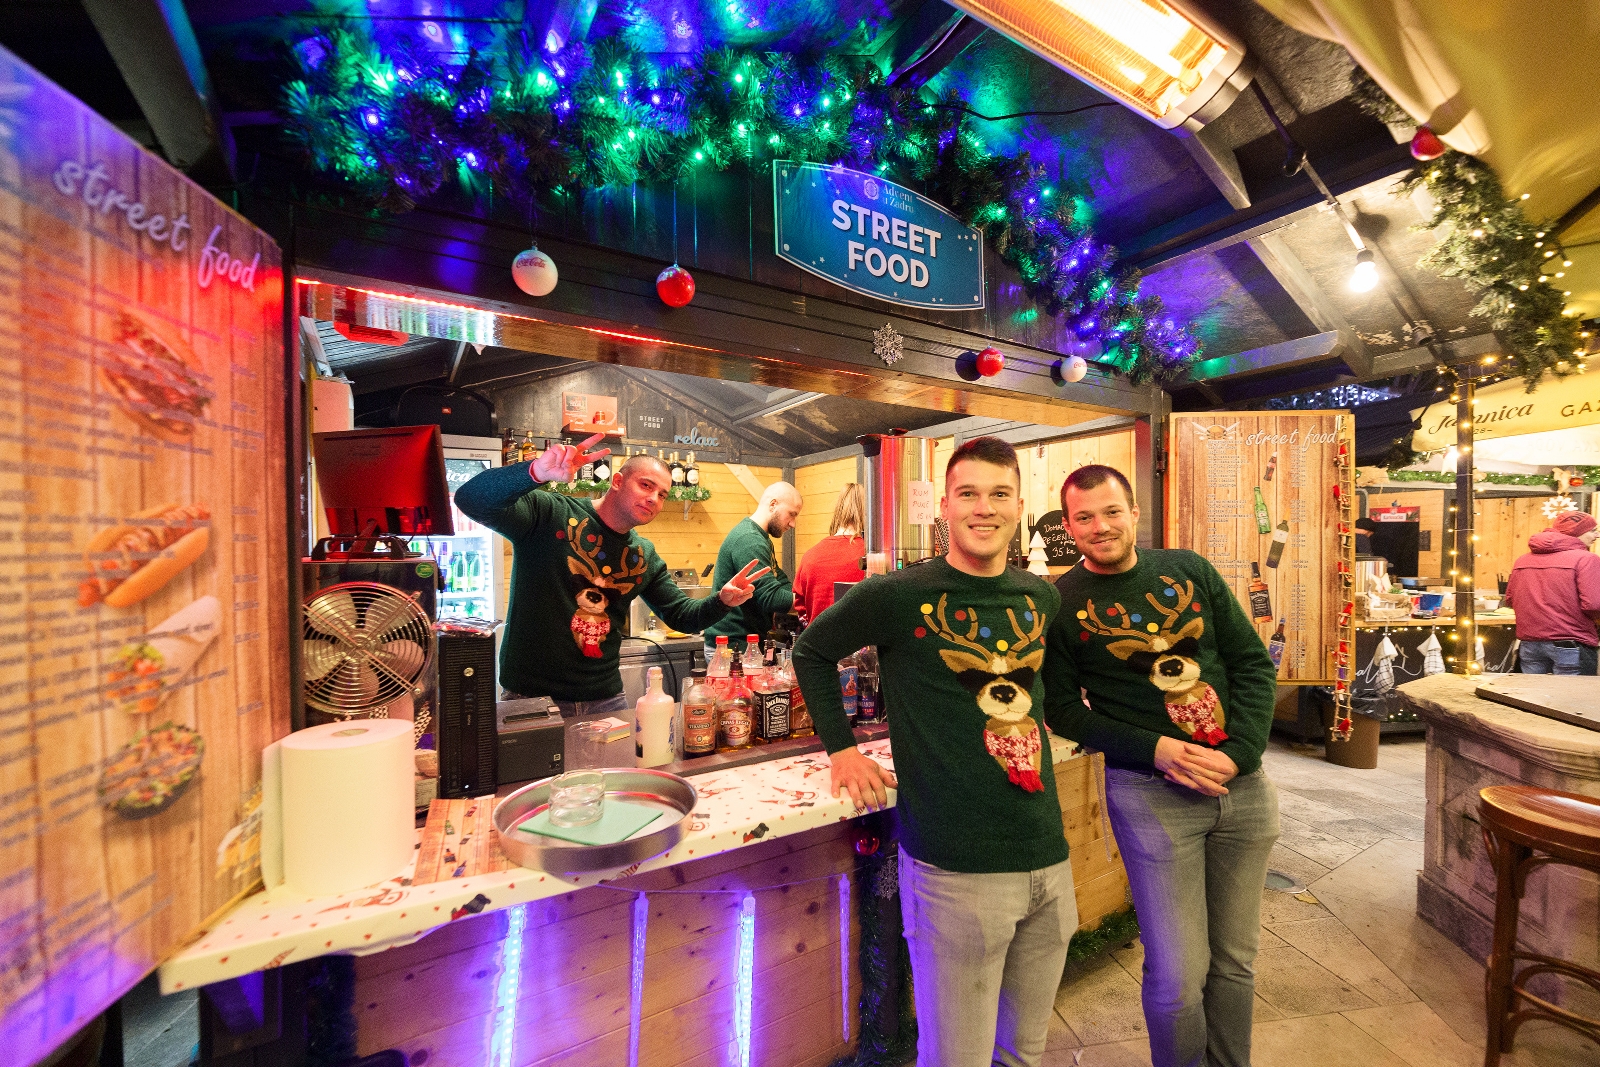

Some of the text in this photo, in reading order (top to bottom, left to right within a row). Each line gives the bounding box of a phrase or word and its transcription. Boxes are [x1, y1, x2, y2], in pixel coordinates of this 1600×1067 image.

[884, 184, 913, 203] Advent
[889, 196, 914, 213] Zadru
[53, 159, 191, 251] street
[199, 225, 261, 291] food
[831, 199, 941, 258] STREET
[848, 240, 929, 288] FOOD
[639, 415, 664, 423] STREET
[643, 421, 661, 429] FOOD
[673, 426, 719, 447] relax
[1245, 424, 1338, 452] street food
[912, 488, 929, 497] RUM
[1051, 546, 1064, 558] 35
